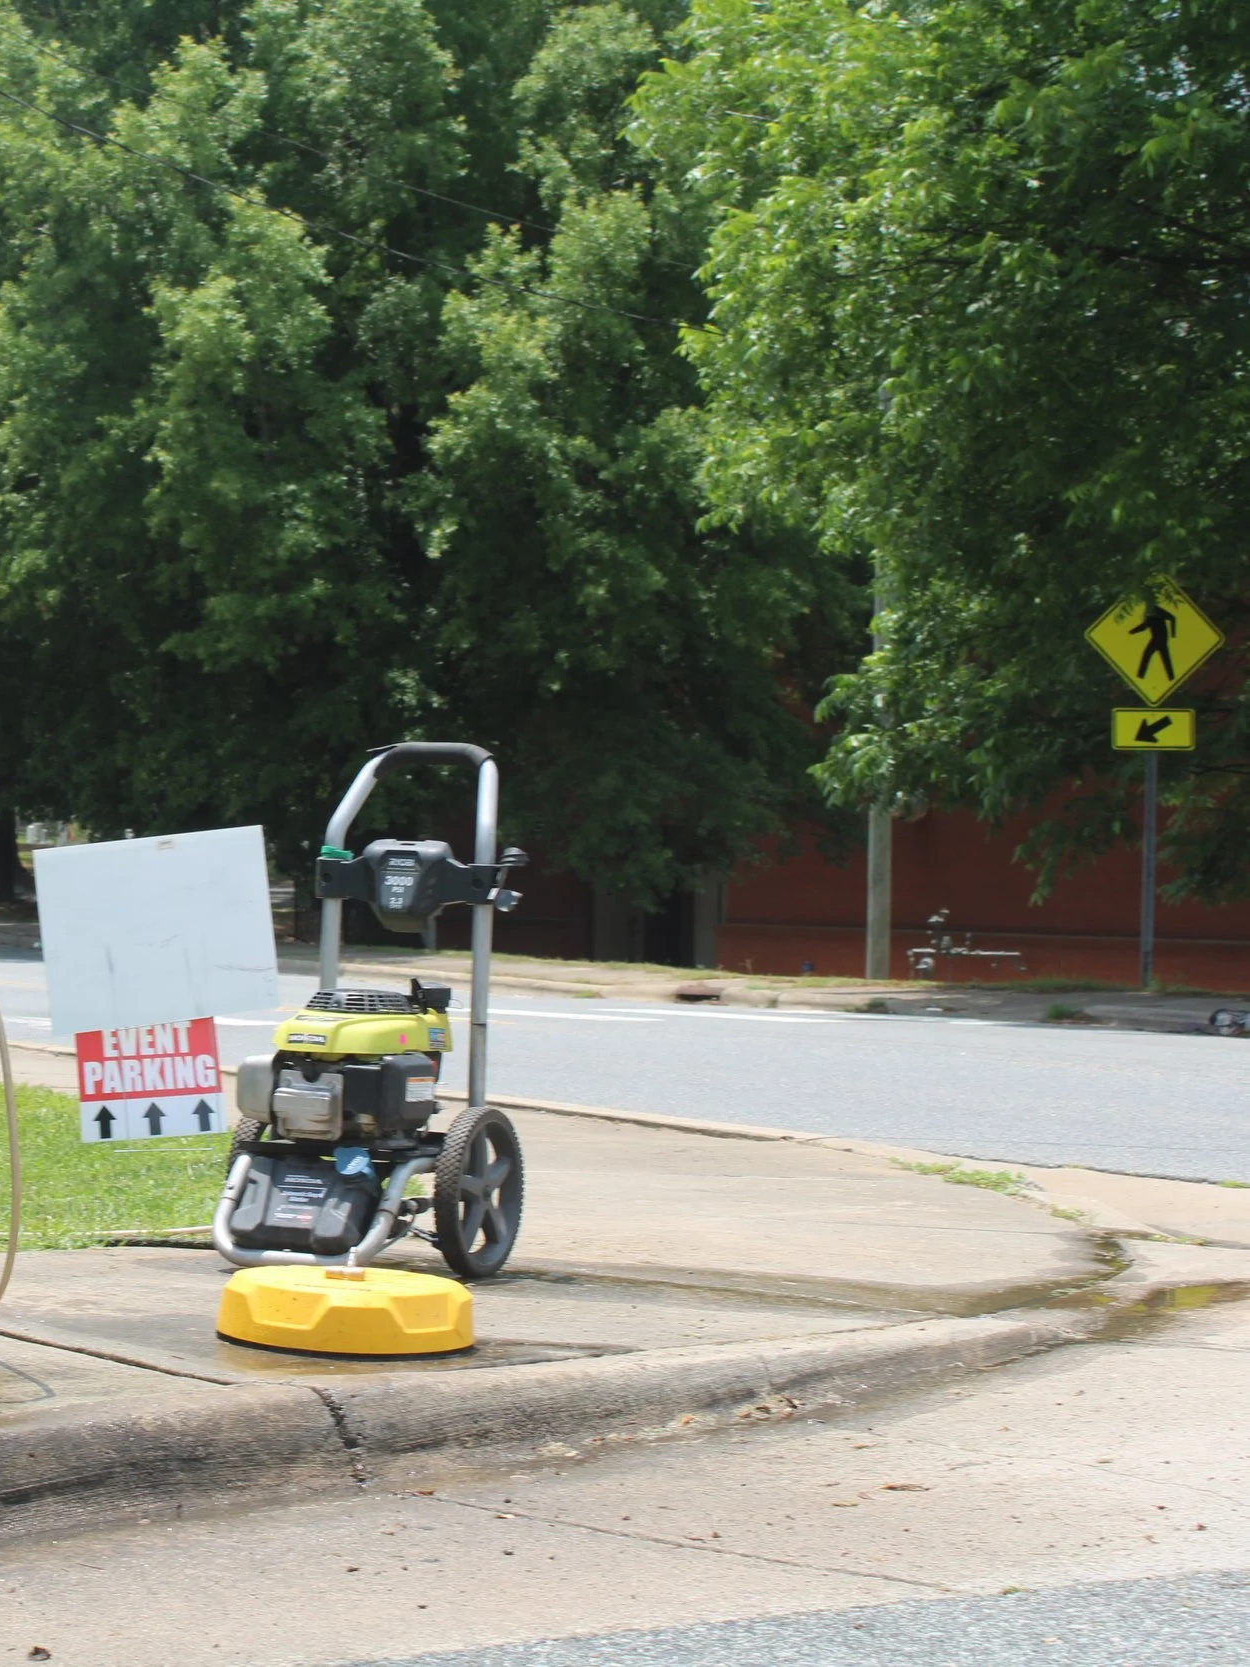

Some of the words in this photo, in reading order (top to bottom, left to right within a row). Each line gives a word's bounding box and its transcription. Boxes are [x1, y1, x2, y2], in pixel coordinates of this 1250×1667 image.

[383, 875, 415, 887] 3000
[102, 1021, 191, 1057] EVENT
[83, 1054, 217, 1095] PARKING
